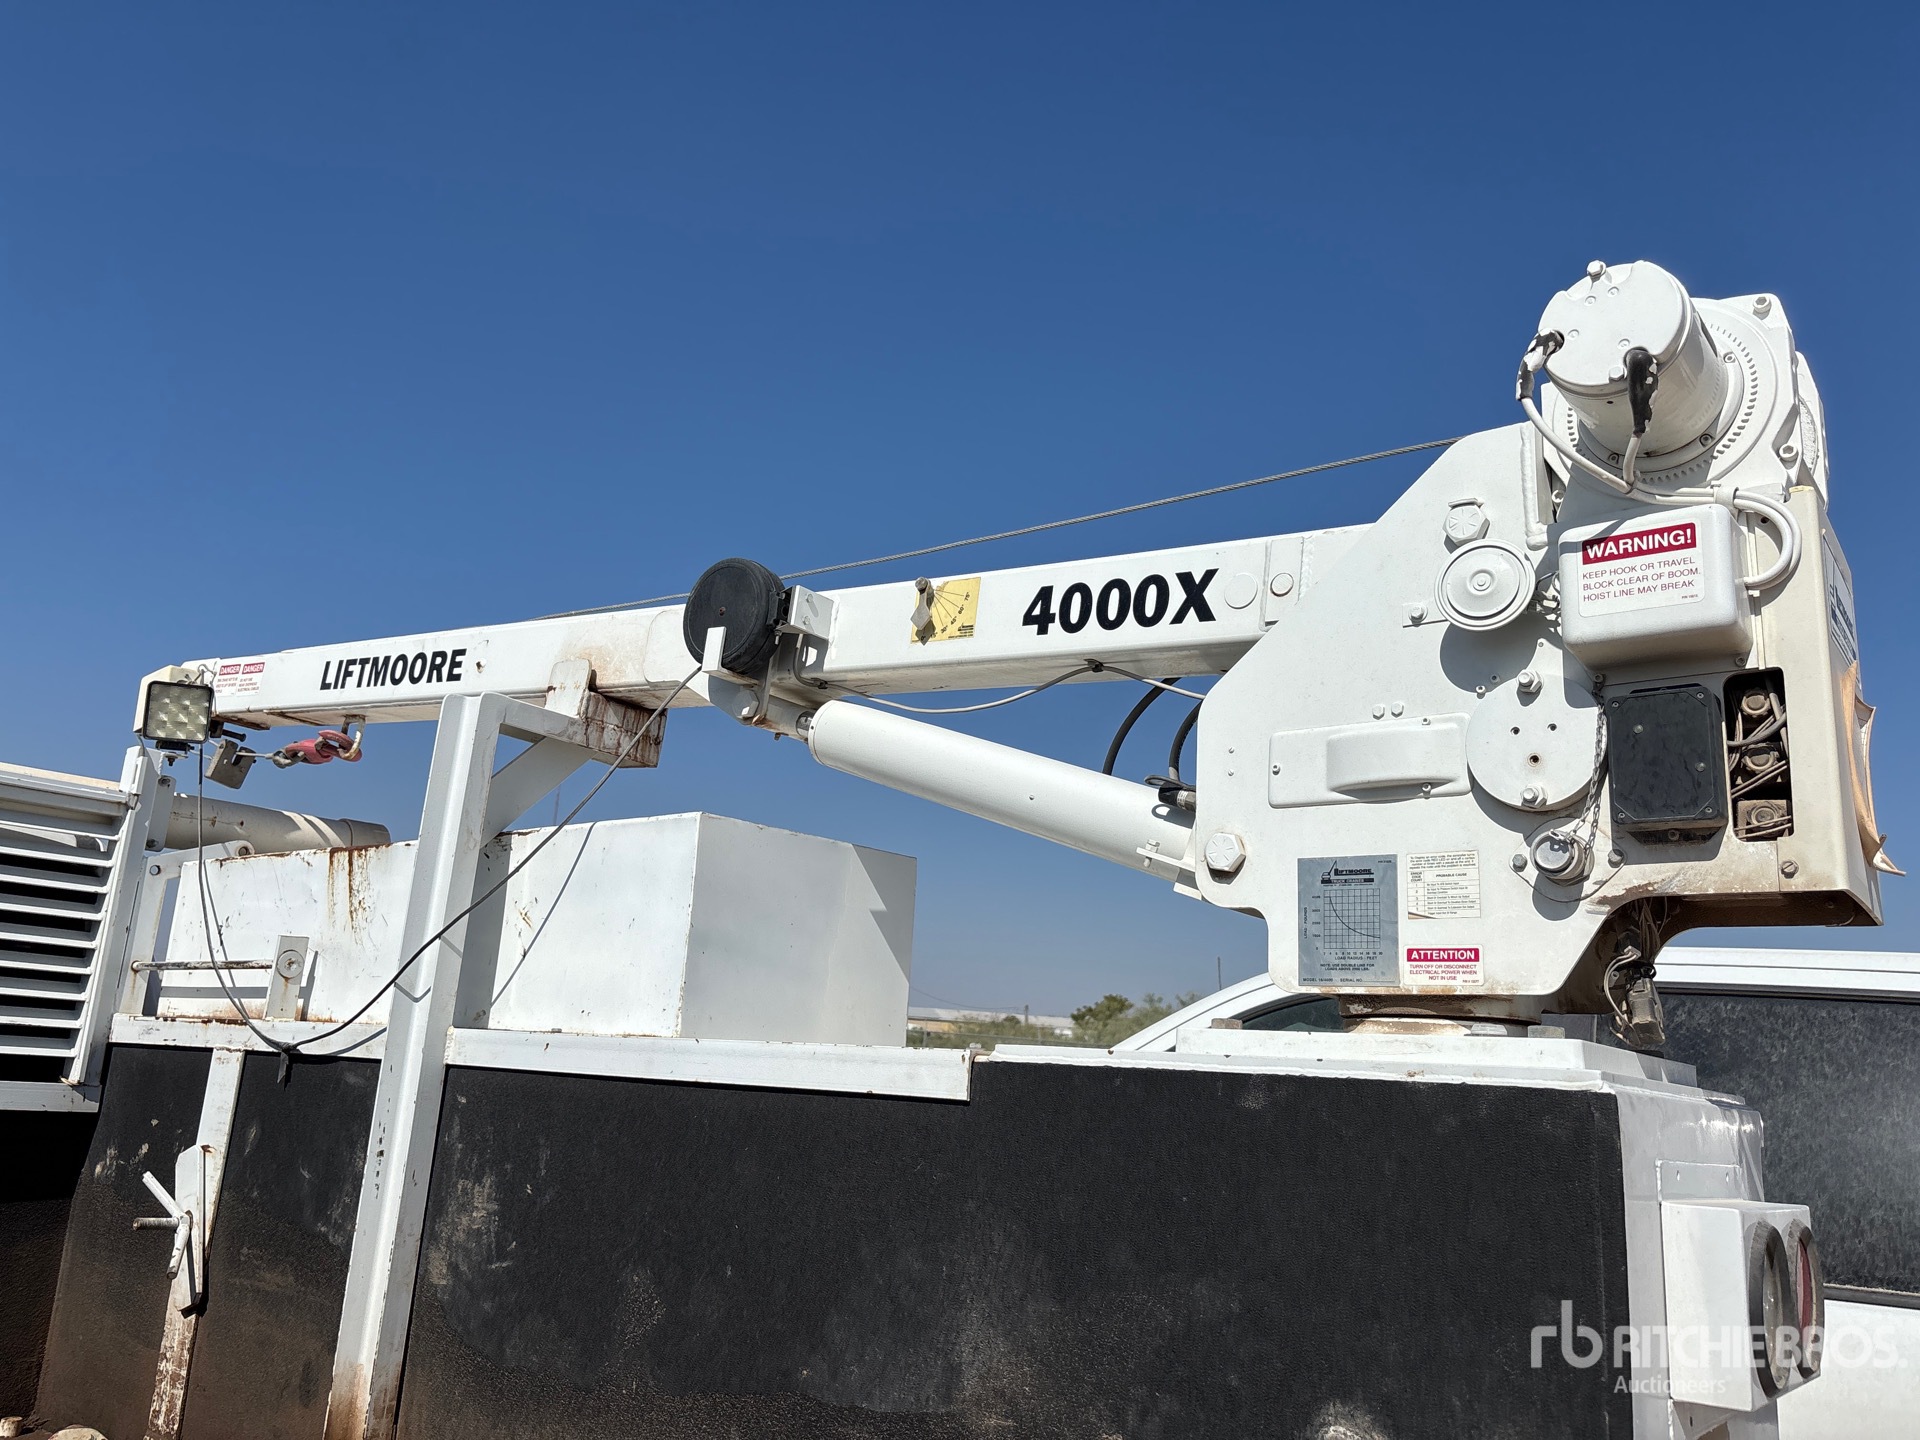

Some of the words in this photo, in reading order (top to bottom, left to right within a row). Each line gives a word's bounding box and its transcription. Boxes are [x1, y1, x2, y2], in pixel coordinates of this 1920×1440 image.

[1586, 529, 1692, 559] WARNING!
[1582, 570, 1608, 580] KEEP
[1609, 565, 1638, 576] HOOK
[1640, 562, 1655, 571] OR
[1657, 557, 1695, 569] TRAVEL
[1582, 580, 1614, 591] BLOCK
[1616, 575, 1649, 587] CLEAR
[1651, 573, 1665, 582] OF
[1668, 568, 1701, 579] BOOM.
[1022, 568, 1220, 636] 4000X
[1583, 592, 1612, 602] HOIST
[1614, 587, 1635, 598] LINE
[1637, 584, 1658, 595] MAY
[1660, 580, 1694, 592] BREAK
[220, 665, 240, 674] DANGER
[244, 664, 263, 674] DANGER
[320, 648, 468, 691] LIFTMOORE
[1411, 950, 1475, 959] ATTENTION
